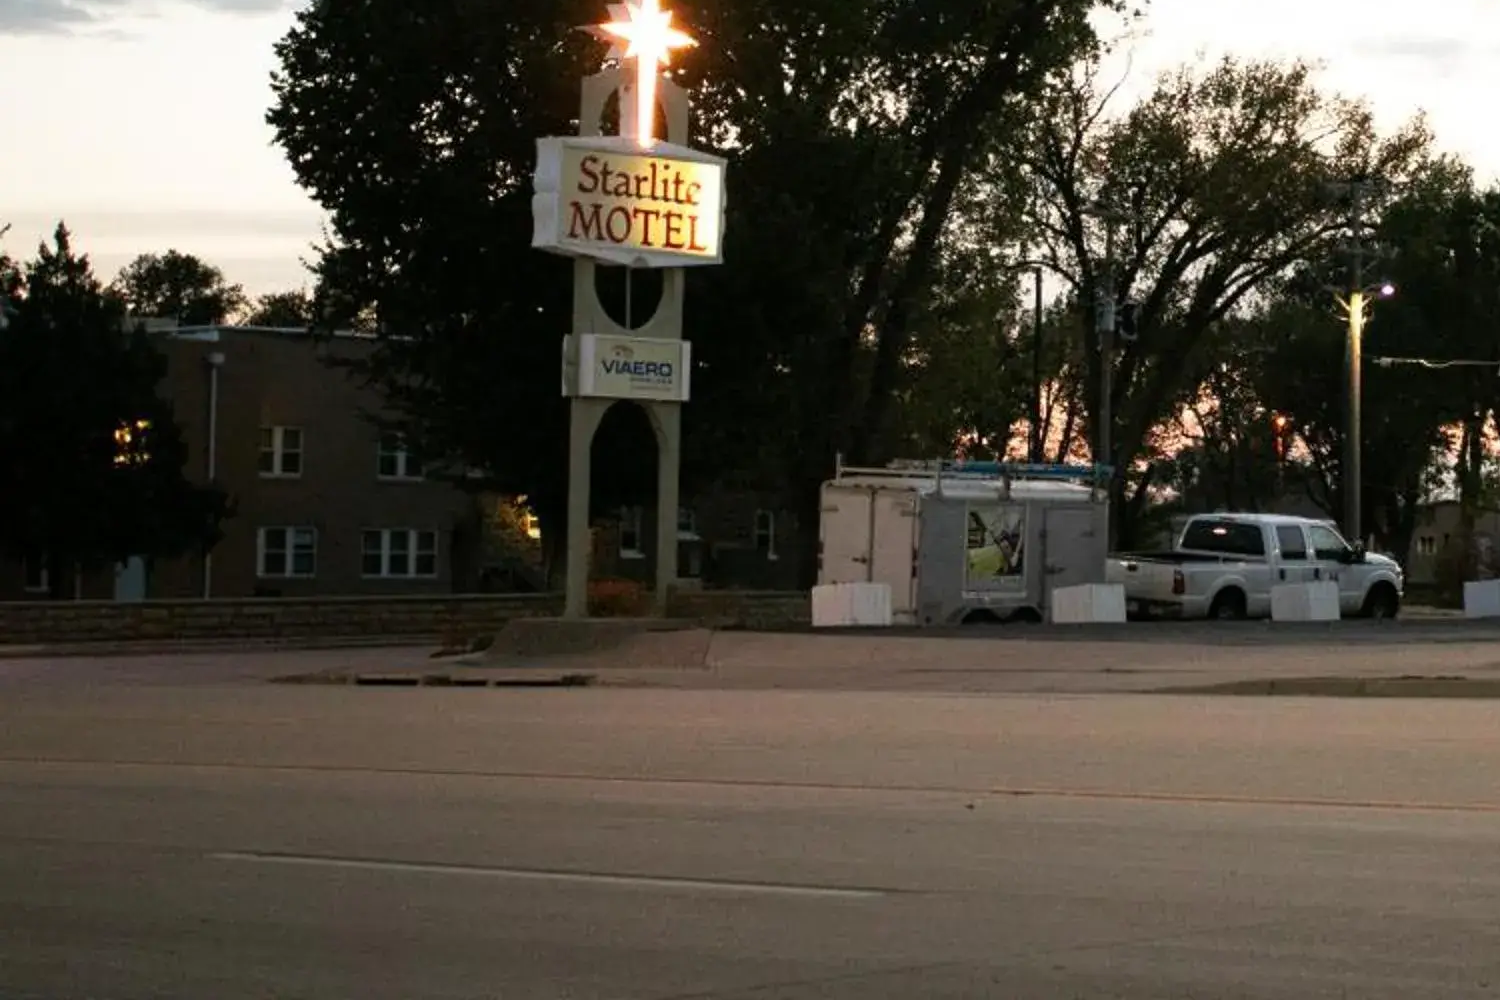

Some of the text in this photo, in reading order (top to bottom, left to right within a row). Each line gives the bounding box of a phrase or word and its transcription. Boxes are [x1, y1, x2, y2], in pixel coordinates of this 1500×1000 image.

[577, 154, 702, 205] Starlite
[567, 200, 707, 251] MOTEL
[601, 359, 673, 377] VIAERO
